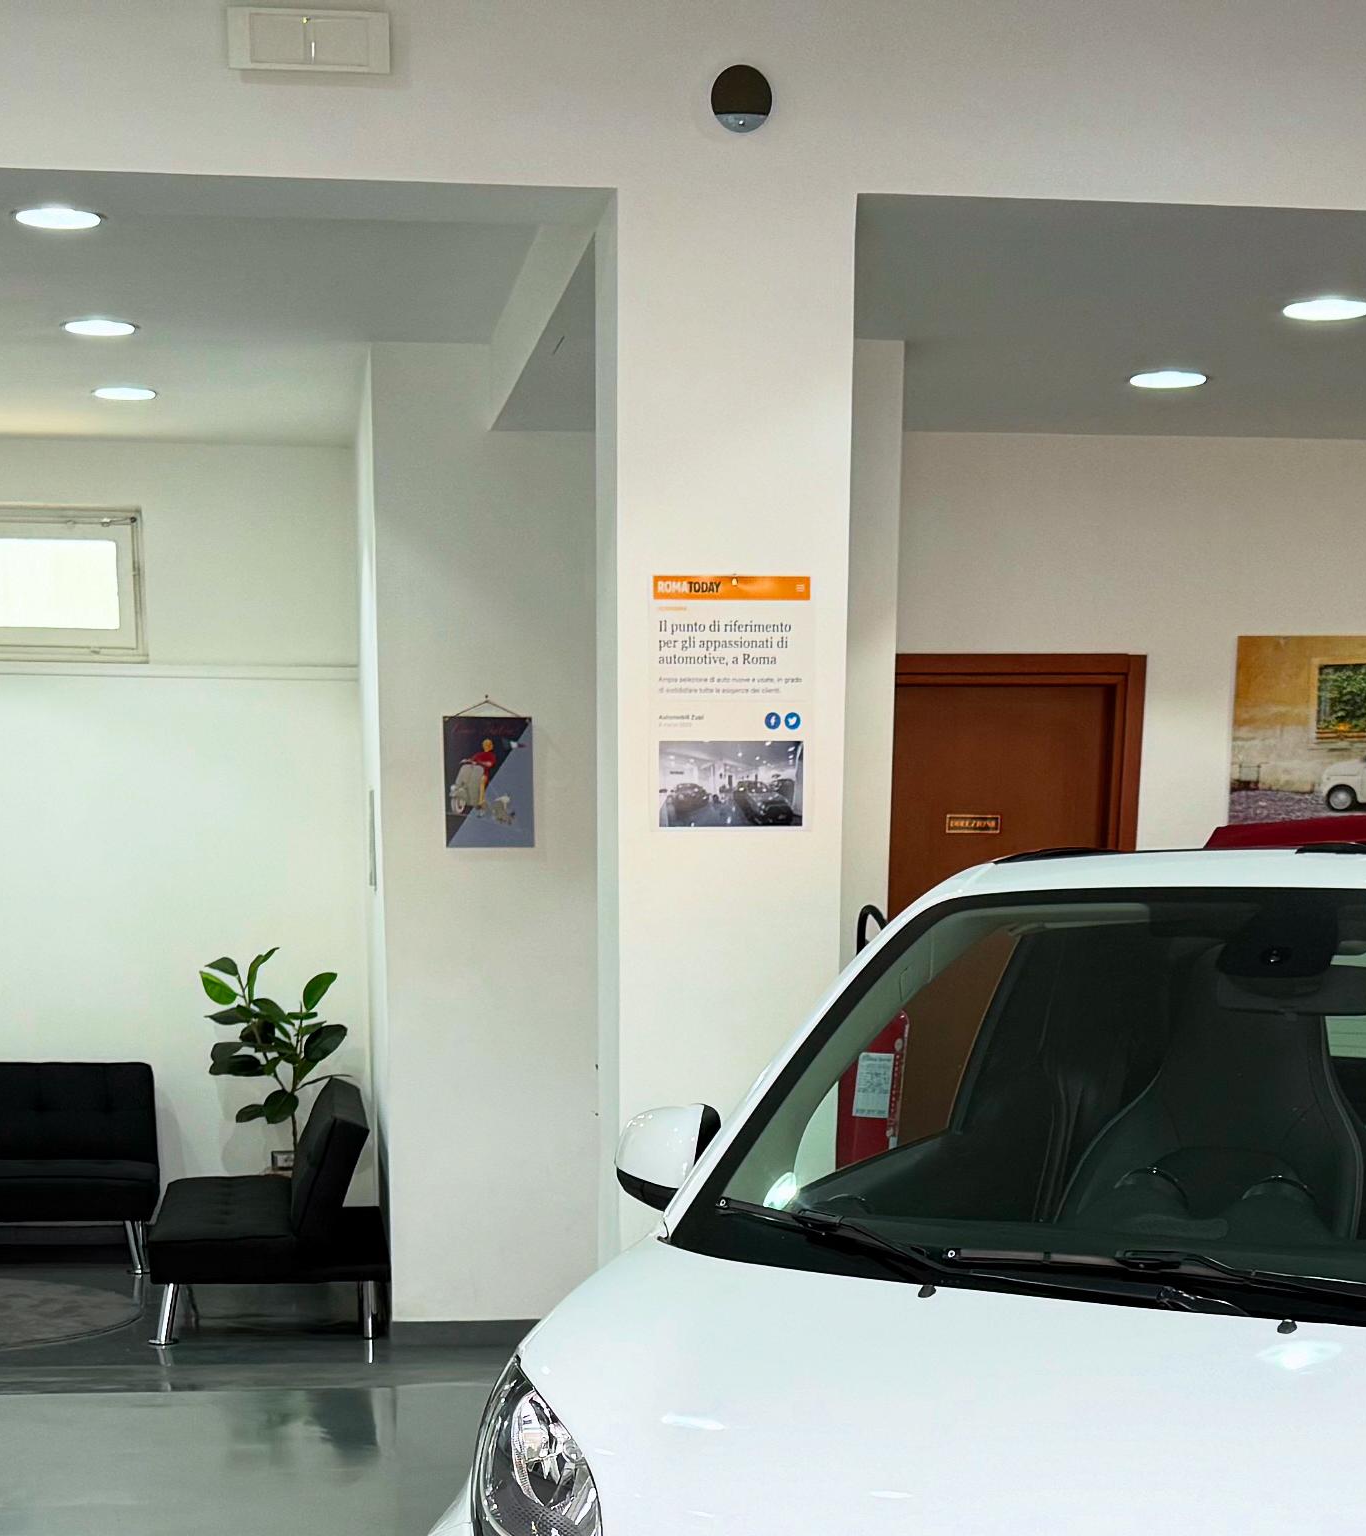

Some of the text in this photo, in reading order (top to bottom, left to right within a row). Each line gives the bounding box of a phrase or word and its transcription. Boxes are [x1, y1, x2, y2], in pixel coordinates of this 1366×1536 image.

[659, 620, 792, 635] Il punto di riferimento
[658, 636, 788, 651] per gli appassionati di
[658, 653, 777, 666] automotive, a Roma
